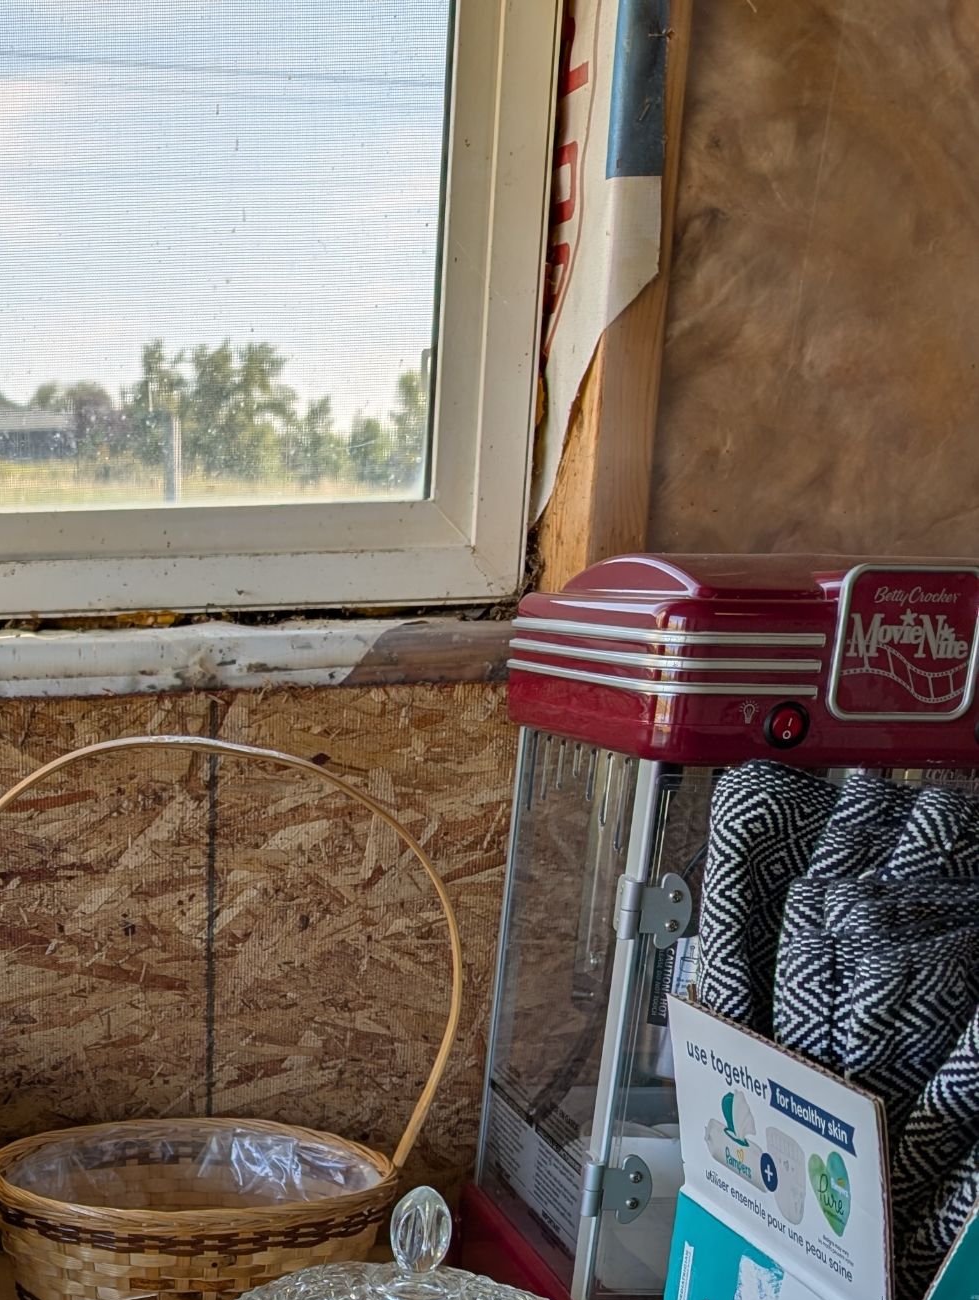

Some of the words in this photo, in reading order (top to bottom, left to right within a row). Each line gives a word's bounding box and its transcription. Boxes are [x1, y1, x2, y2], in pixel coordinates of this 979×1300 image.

[874, 586, 908, 607] Betty
[909, 586, 959, 605] Crocker
[686, 1040, 708, 1066] use
[710, 1050, 768, 1099] together
[775, 1087, 790, 1106] for
[791, 1096, 827, 1132] healthy
[827, 1120, 848, 1145] skin
[725, 1146, 752, 1179] Pampers
[817, 1173, 844, 1216] Pure
[705, 1169, 730, 1193] utiliser
[730, 1186, 767, 1220] ensemble
[767, 1213, 787, 1235] pour
[788, 1228, 804, 1247] une
[805, 1240, 828, 1264] peau
[828, 1257, 853, 1283] saine
